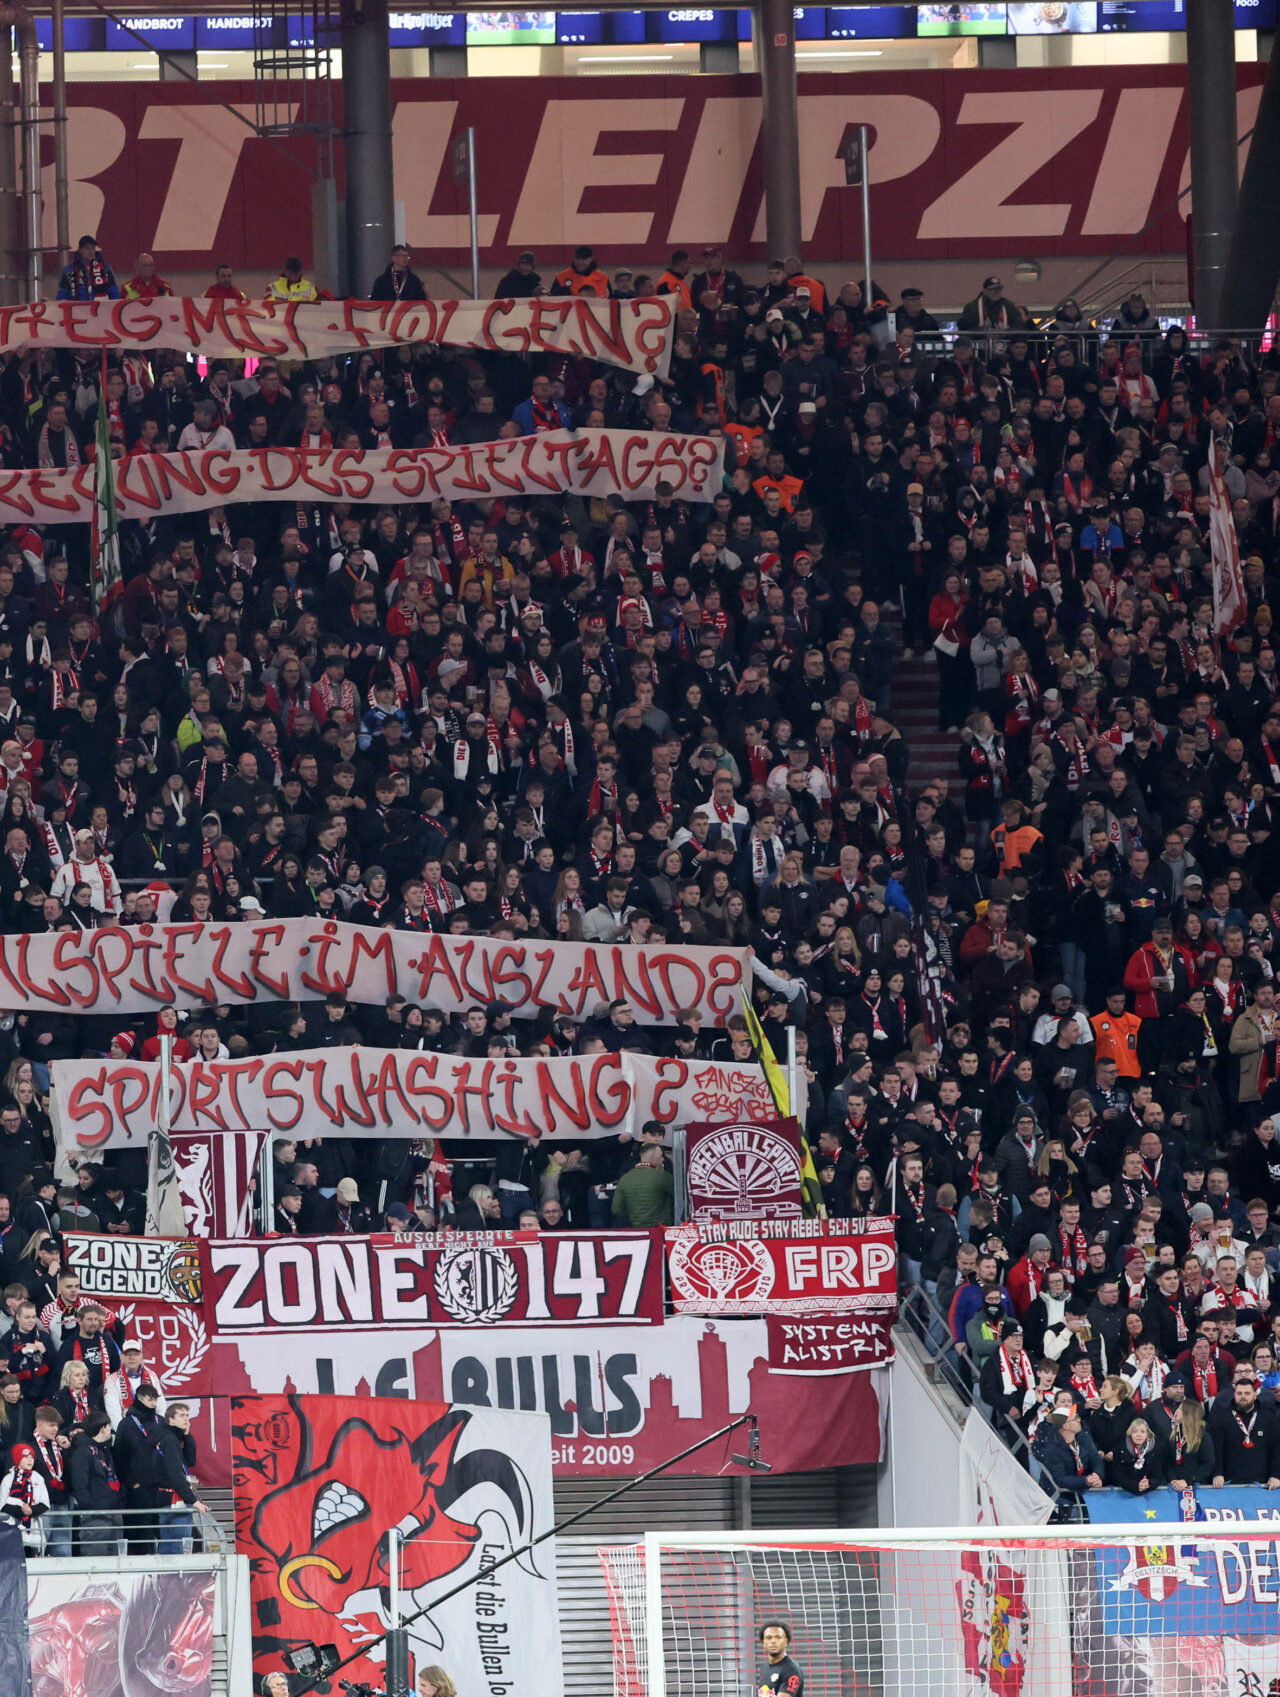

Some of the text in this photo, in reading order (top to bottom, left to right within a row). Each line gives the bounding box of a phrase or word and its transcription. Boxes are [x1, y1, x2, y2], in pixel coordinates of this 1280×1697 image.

[384, 84, 1266, 250] LEIPZI
[699, 1224, 728, 1244] STAY
[729, 1220, 760, 1240] RUDE
[761, 1220, 790, 1239] STAY
[67, 1238, 162, 1269] ZONE
[784, 1243, 896, 1291] FRP
[74, 1267, 162, 1294] JUGEND
[211, 1240, 652, 1325] ZONE 147
[551, 1444, 635, 1466] eit 2009
[475, 1591, 505, 1617] die
[476, 1621, 511, 1675] Bullen
[488, 1681, 514, 1697] lo
